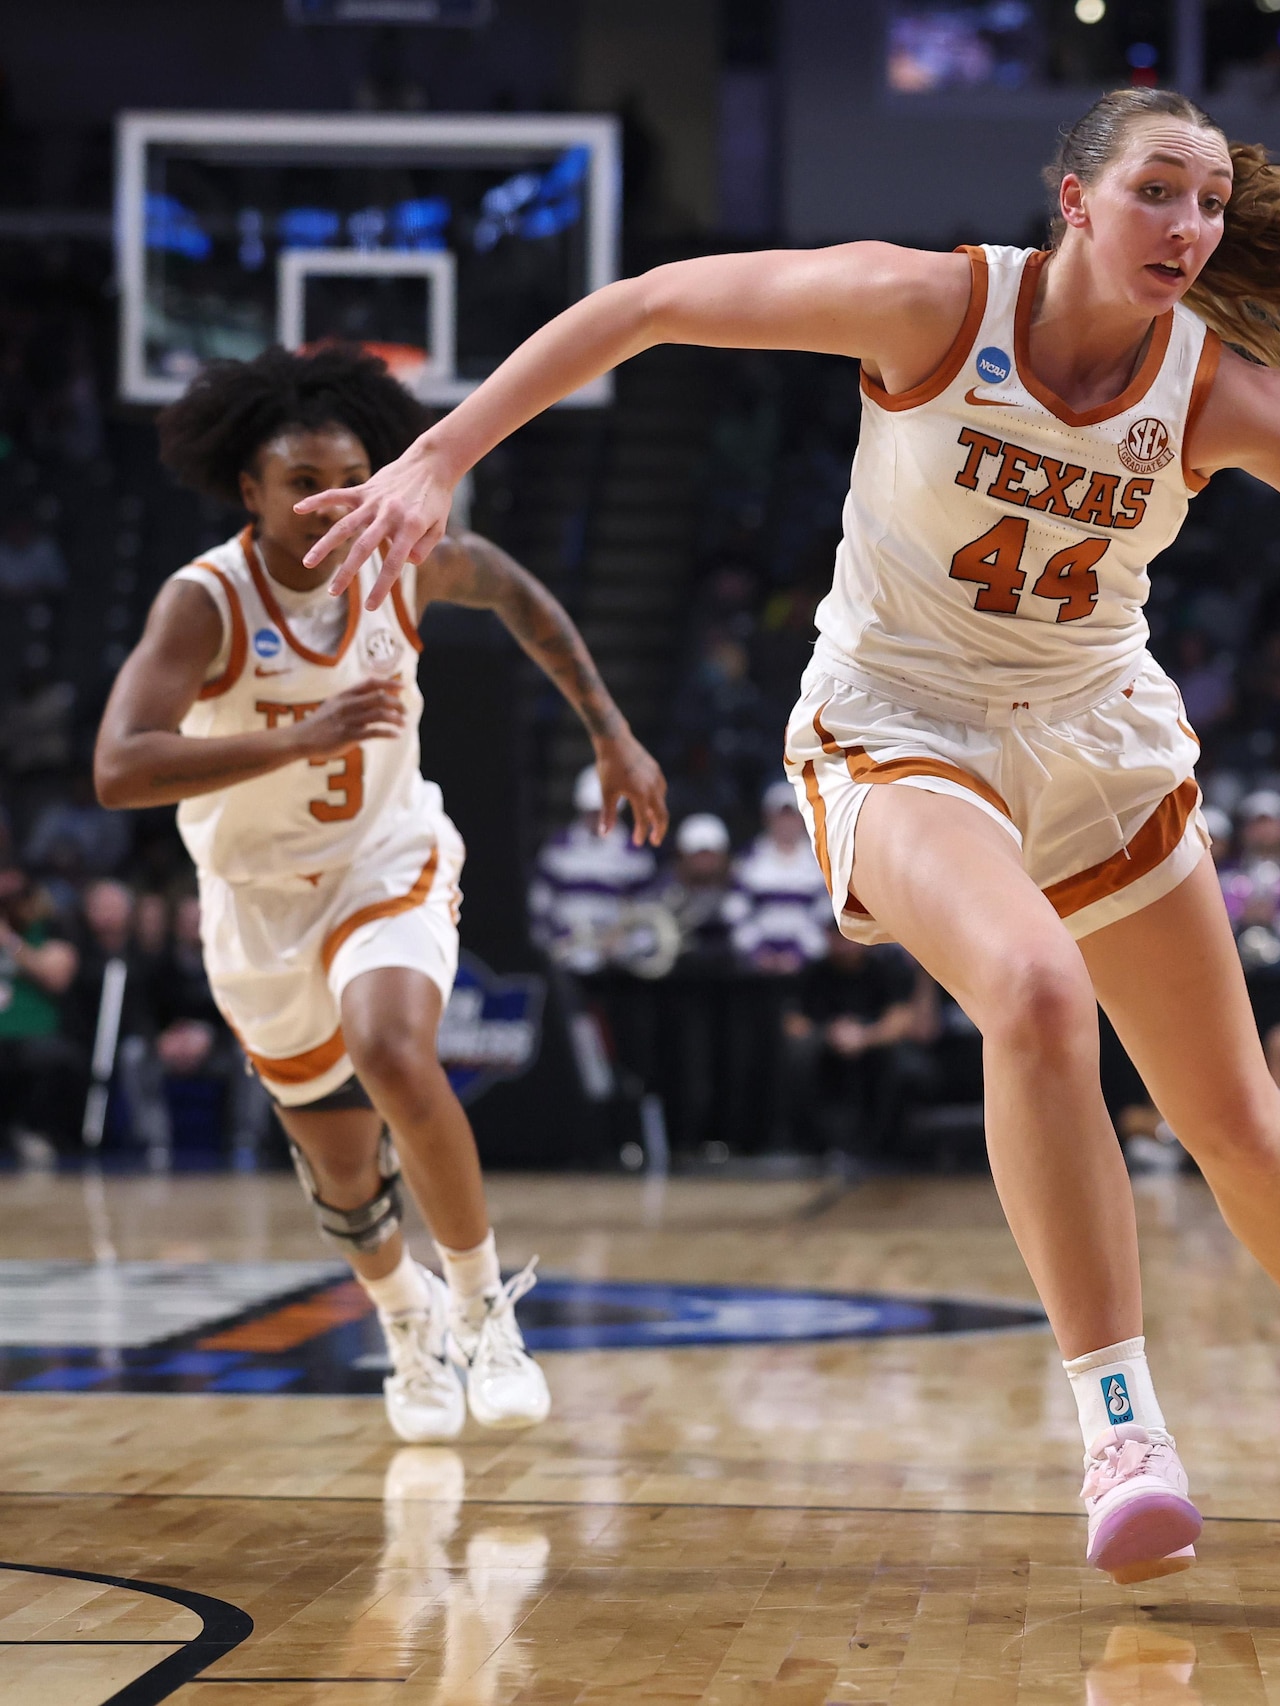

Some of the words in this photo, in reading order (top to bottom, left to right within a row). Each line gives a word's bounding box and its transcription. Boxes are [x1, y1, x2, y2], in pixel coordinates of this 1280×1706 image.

[979, 358, 1007, 379] NCAA
[1121, 451, 1164, 473] GRADUATE
[1129, 419, 1168, 460] SEC
[954, 426, 1155, 530] TEXAS
[948, 514, 1112, 624] 44
[308, 741, 364, 824] 3
